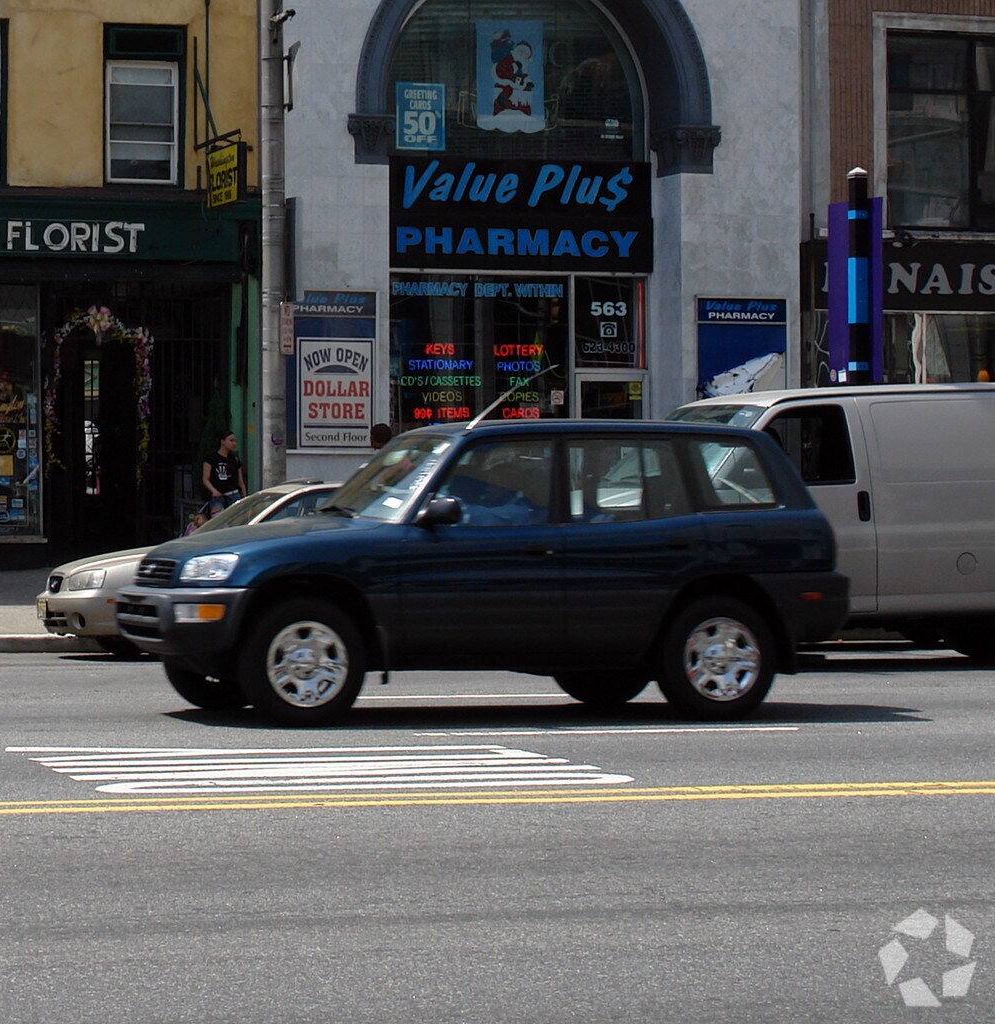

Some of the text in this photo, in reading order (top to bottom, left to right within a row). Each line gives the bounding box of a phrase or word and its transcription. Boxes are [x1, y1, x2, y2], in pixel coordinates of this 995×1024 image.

[404, 89, 438, 100] GREETING
[409, 100, 432, 110] CARDS
[404, 135, 437, 143] OFF
[402, 160, 520, 209] Value
[6, 220, 145, 254] FLORIST
[395, 226, 639, 258] PHARMACY
[391, 281, 563, 298] PHARMACY DEPT. WITHIN
[293, 305, 364, 313] PHARMACY
[589, 301, 627, 317] 563
[705, 300, 778, 312] Value Plus
[708, 312, 776, 320] PHARMACY
[425, 343, 455, 355] KEYS
[493, 344, 544, 357] LOTTERY
[582, 342, 636, 354] 623-4300
[304, 347, 369, 372] NOW OPEN
[408, 359, 473, 371] STATIONARY
[496, 361, 541, 372] PHOTOS
[509, 377, 530, 387] FAX
[303, 380, 369, 397] DOLLAR
[422, 391, 463, 403] VIDEOS
[308, 402, 365, 419] STORE
[437, 407, 470, 419] ITEMS
[502, 407, 540, 419] CARDS
[305, 432, 368, 442] Second Floor
